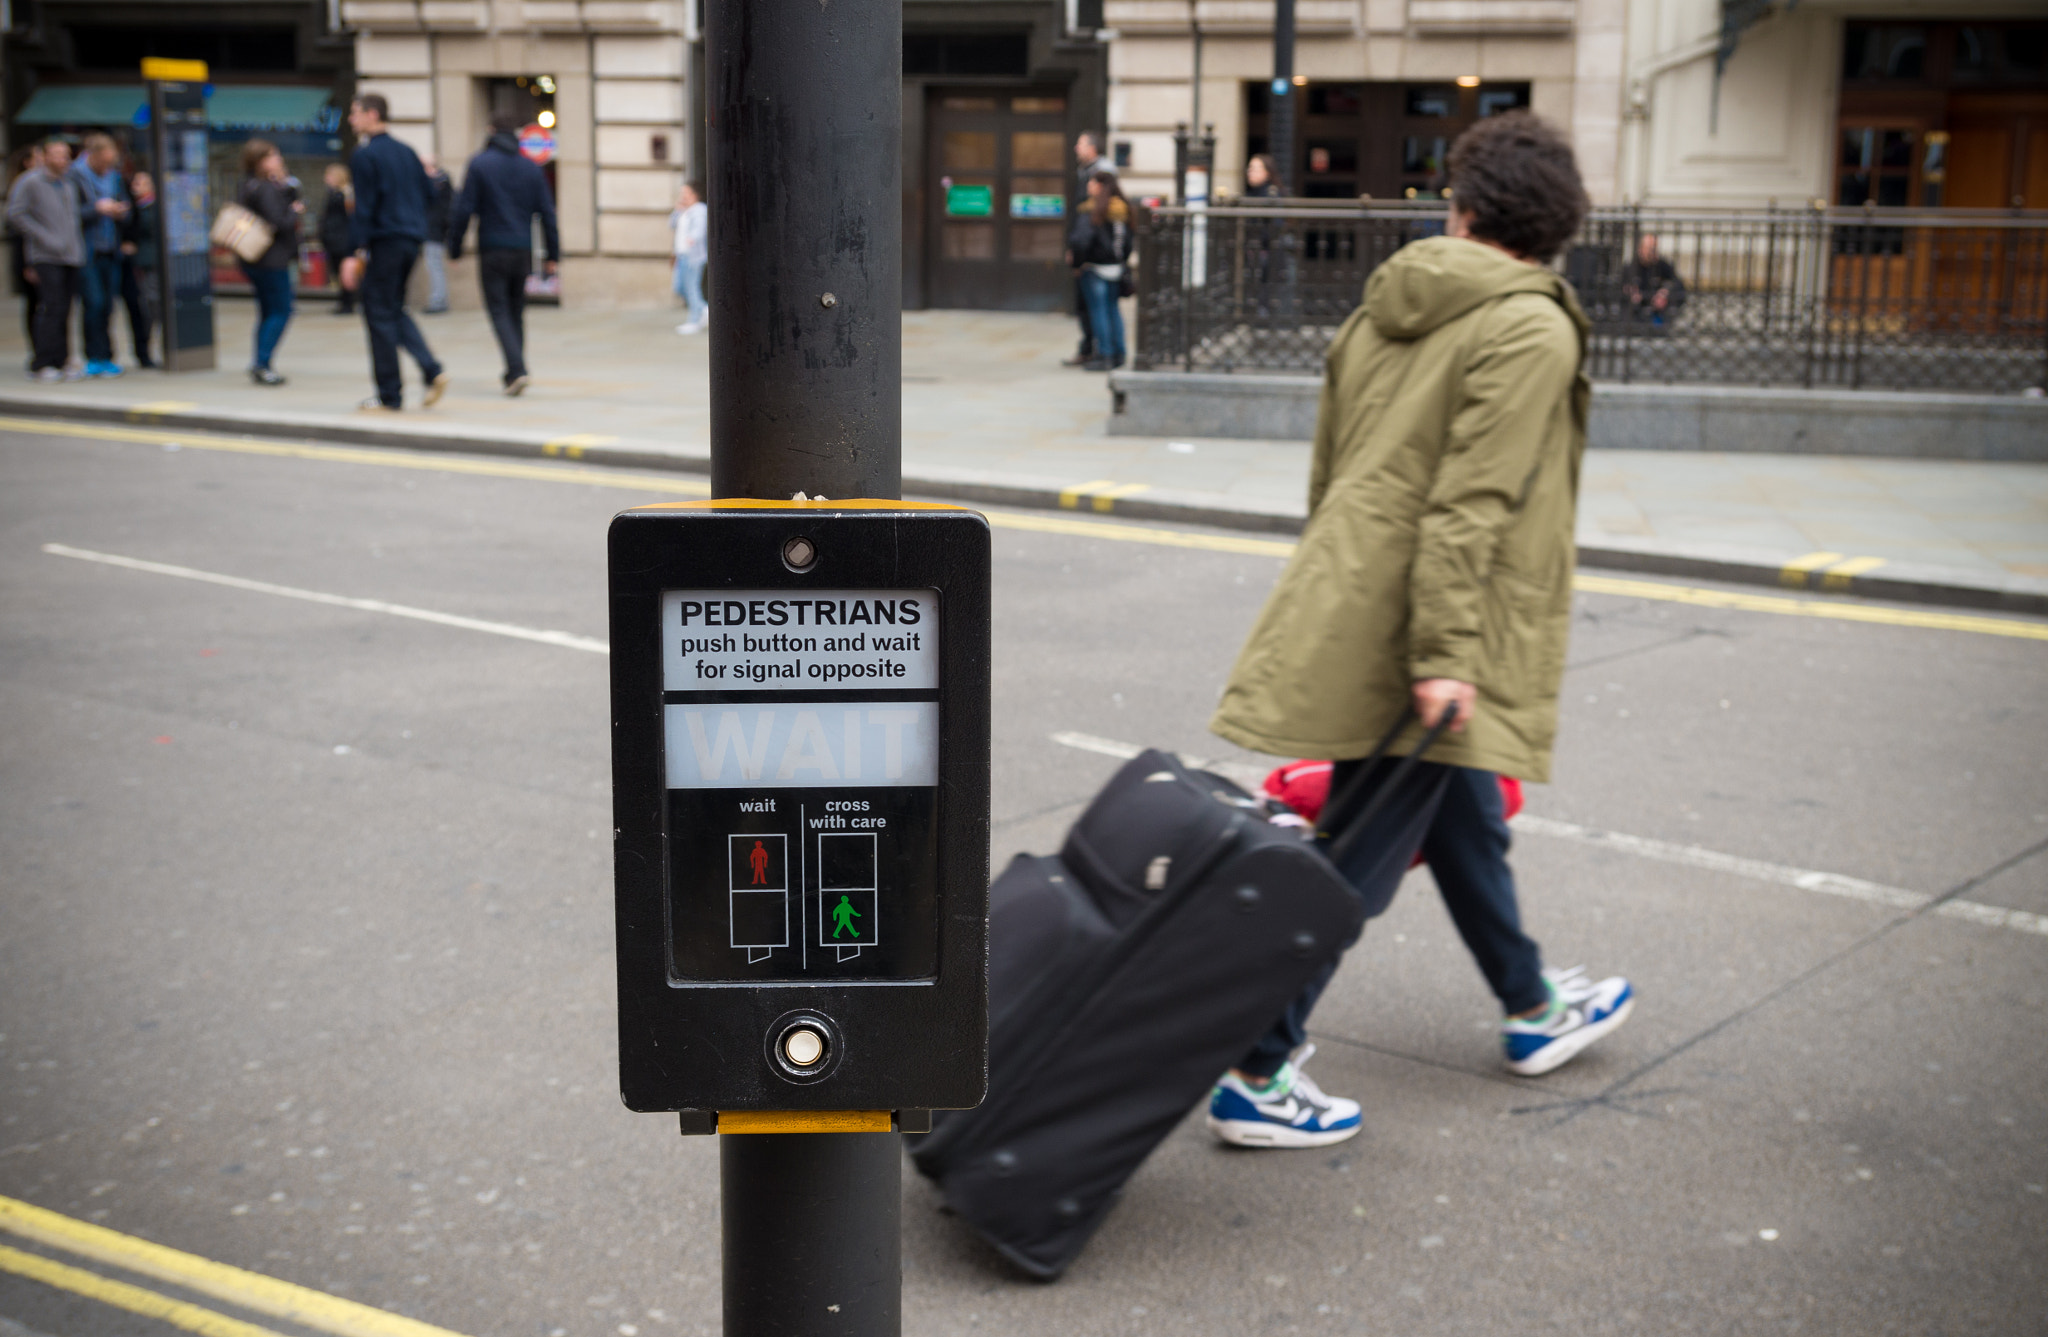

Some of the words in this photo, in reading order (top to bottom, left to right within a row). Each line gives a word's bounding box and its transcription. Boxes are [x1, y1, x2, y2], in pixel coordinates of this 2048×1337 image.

[681, 599, 921, 627] PEDESTRIANS
[681, 633, 737, 657] push
[743, 633, 817, 652] button
[824, 633, 865, 652] and
[871, 632, 921, 651] wait
[695, 660, 727, 679] for
[733, 659, 801, 682] signal
[807, 658, 906, 682] opposite
[685, 710, 919, 781] WAIT
[739, 799, 776, 813] wait
[825, 800, 870, 811] cross
[809, 815, 846, 829] with
[850, 817, 887, 829] care
